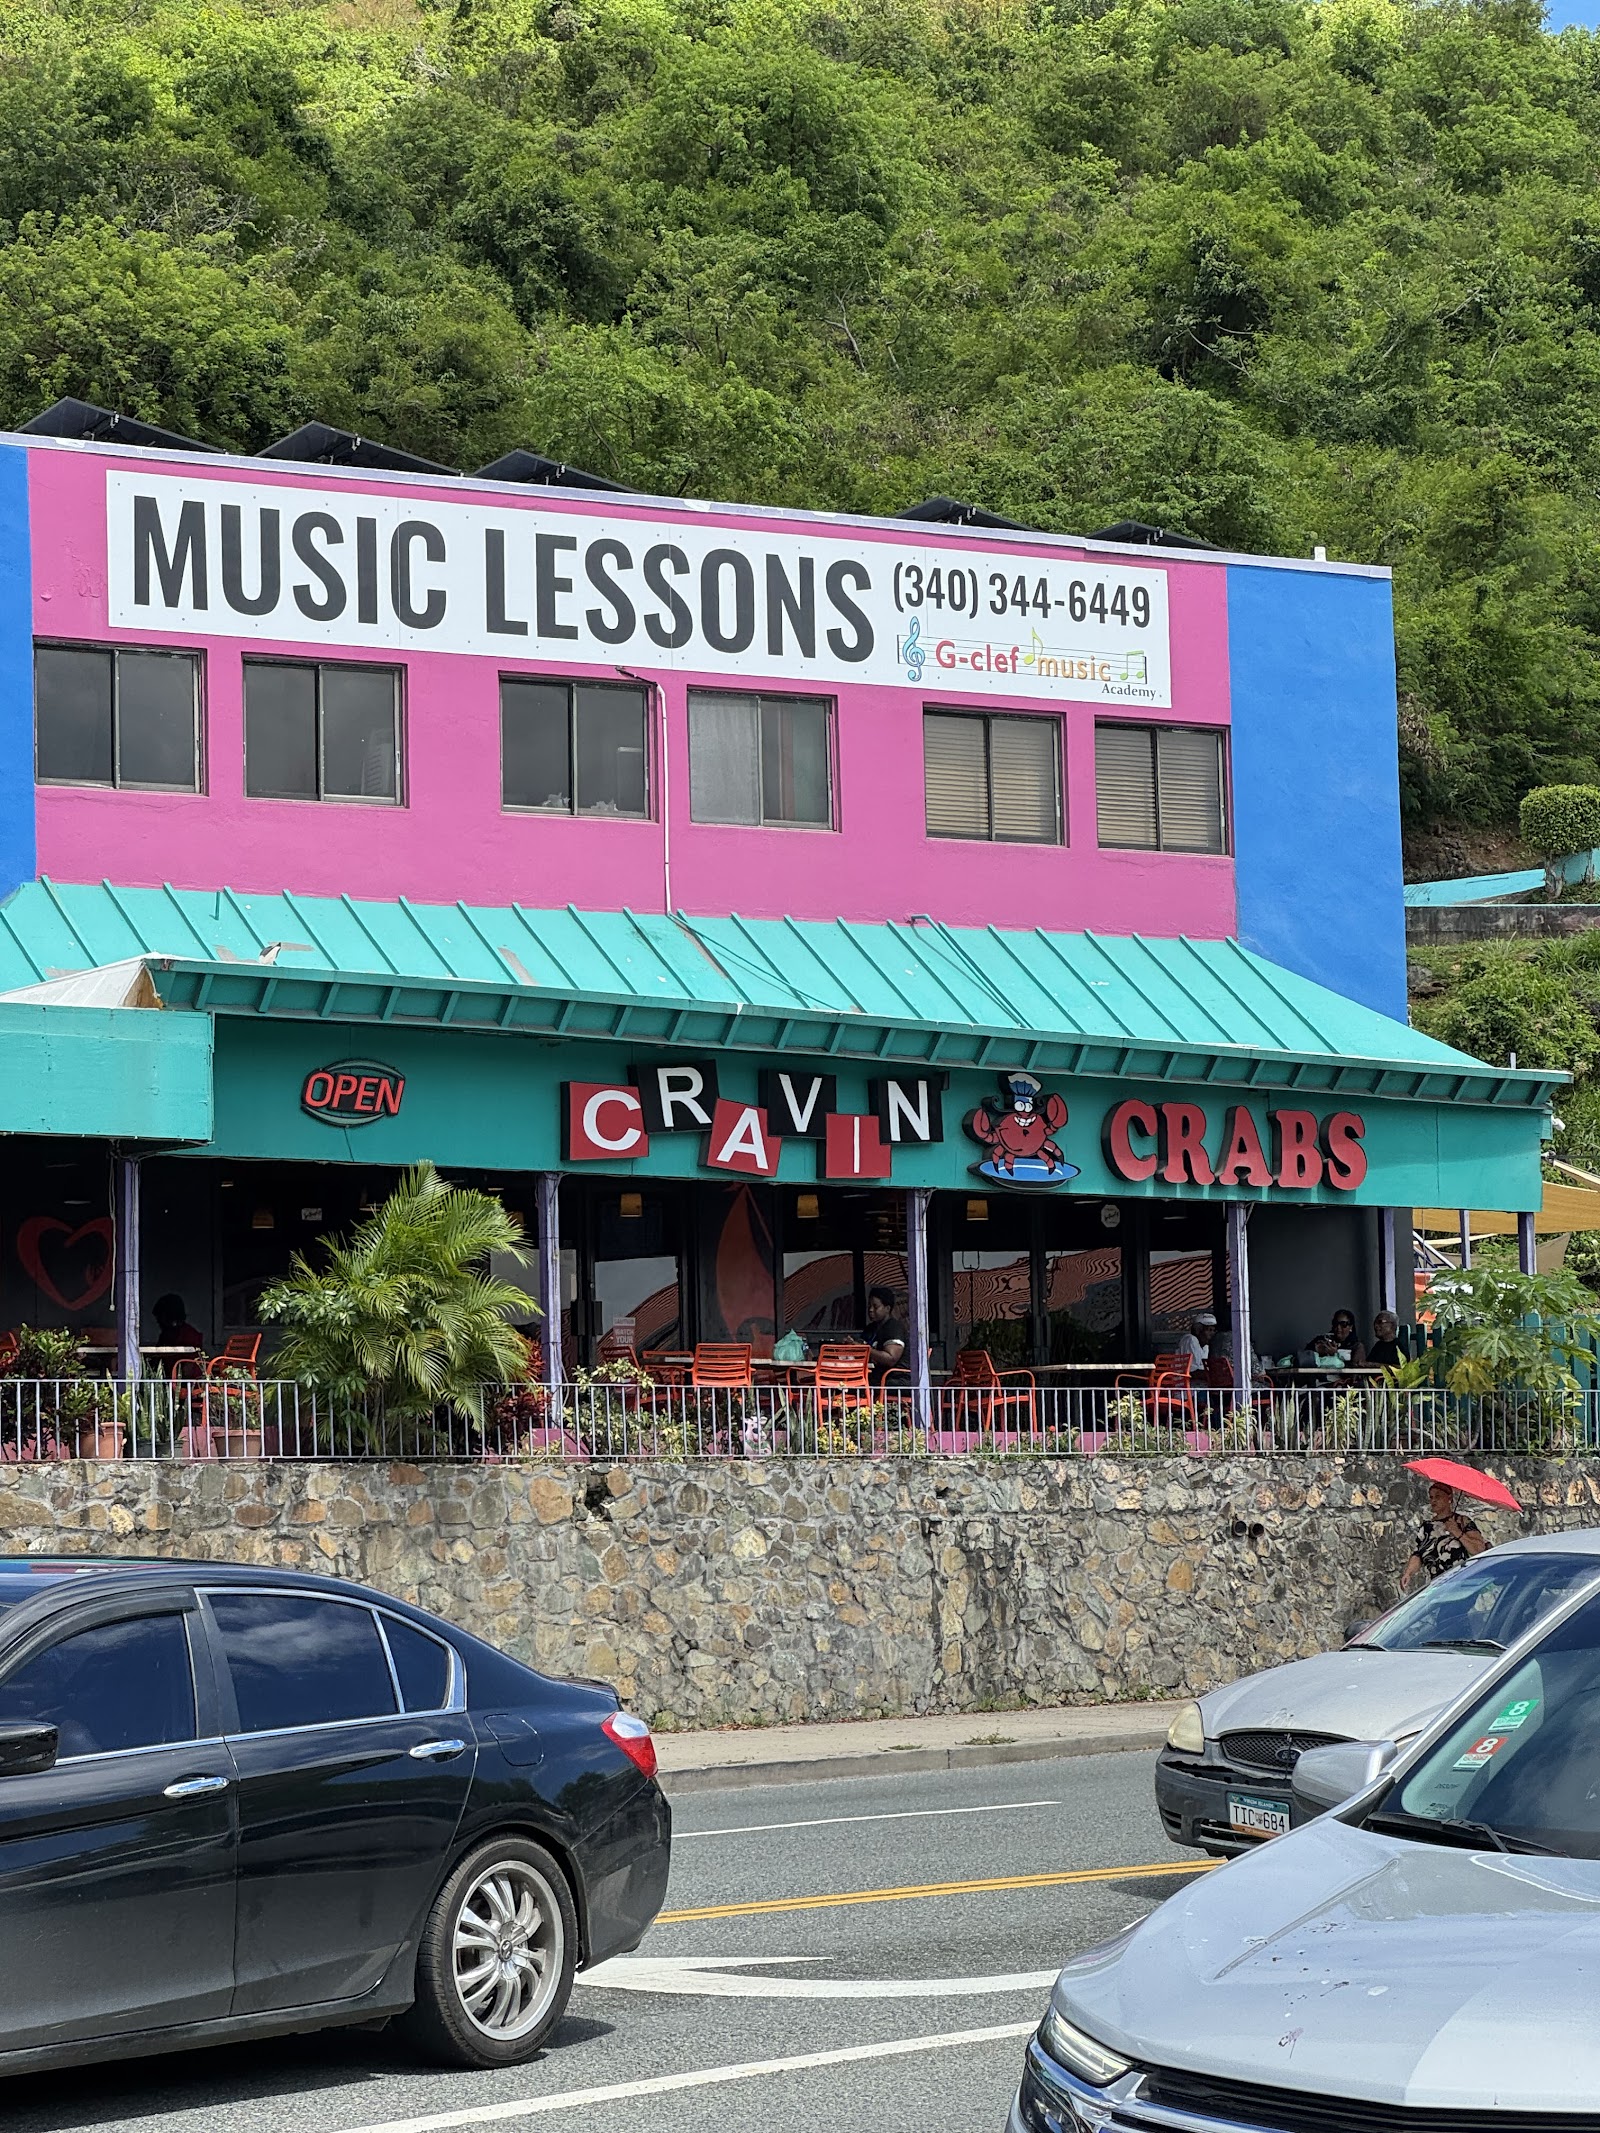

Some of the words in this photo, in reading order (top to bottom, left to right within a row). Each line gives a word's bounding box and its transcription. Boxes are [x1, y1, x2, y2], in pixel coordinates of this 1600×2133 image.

[133, 495, 447, 629] MUSIC
[484, 528, 875, 663] LESSONS
[893, 561, 978, 619] (340)
[988, 573, 1150, 628] 344-6449
[935, 640, 1020, 674] G-clef
[1037, 655, 1111, 682] music
[1101, 682, 1156, 701] Academy
[305, 1071, 405, 1115] OPEN
[582, 1066, 931, 1174] CRAVIN
[1107, 1099, 1368, 1191] CRABS
[1508, 1701, 1530, 1716] 8
[1475, 1738, 1499, 1753] 8
[1233, 1805, 1255, 1826] TIC
[1263, 1812, 1285, 1833] 684
